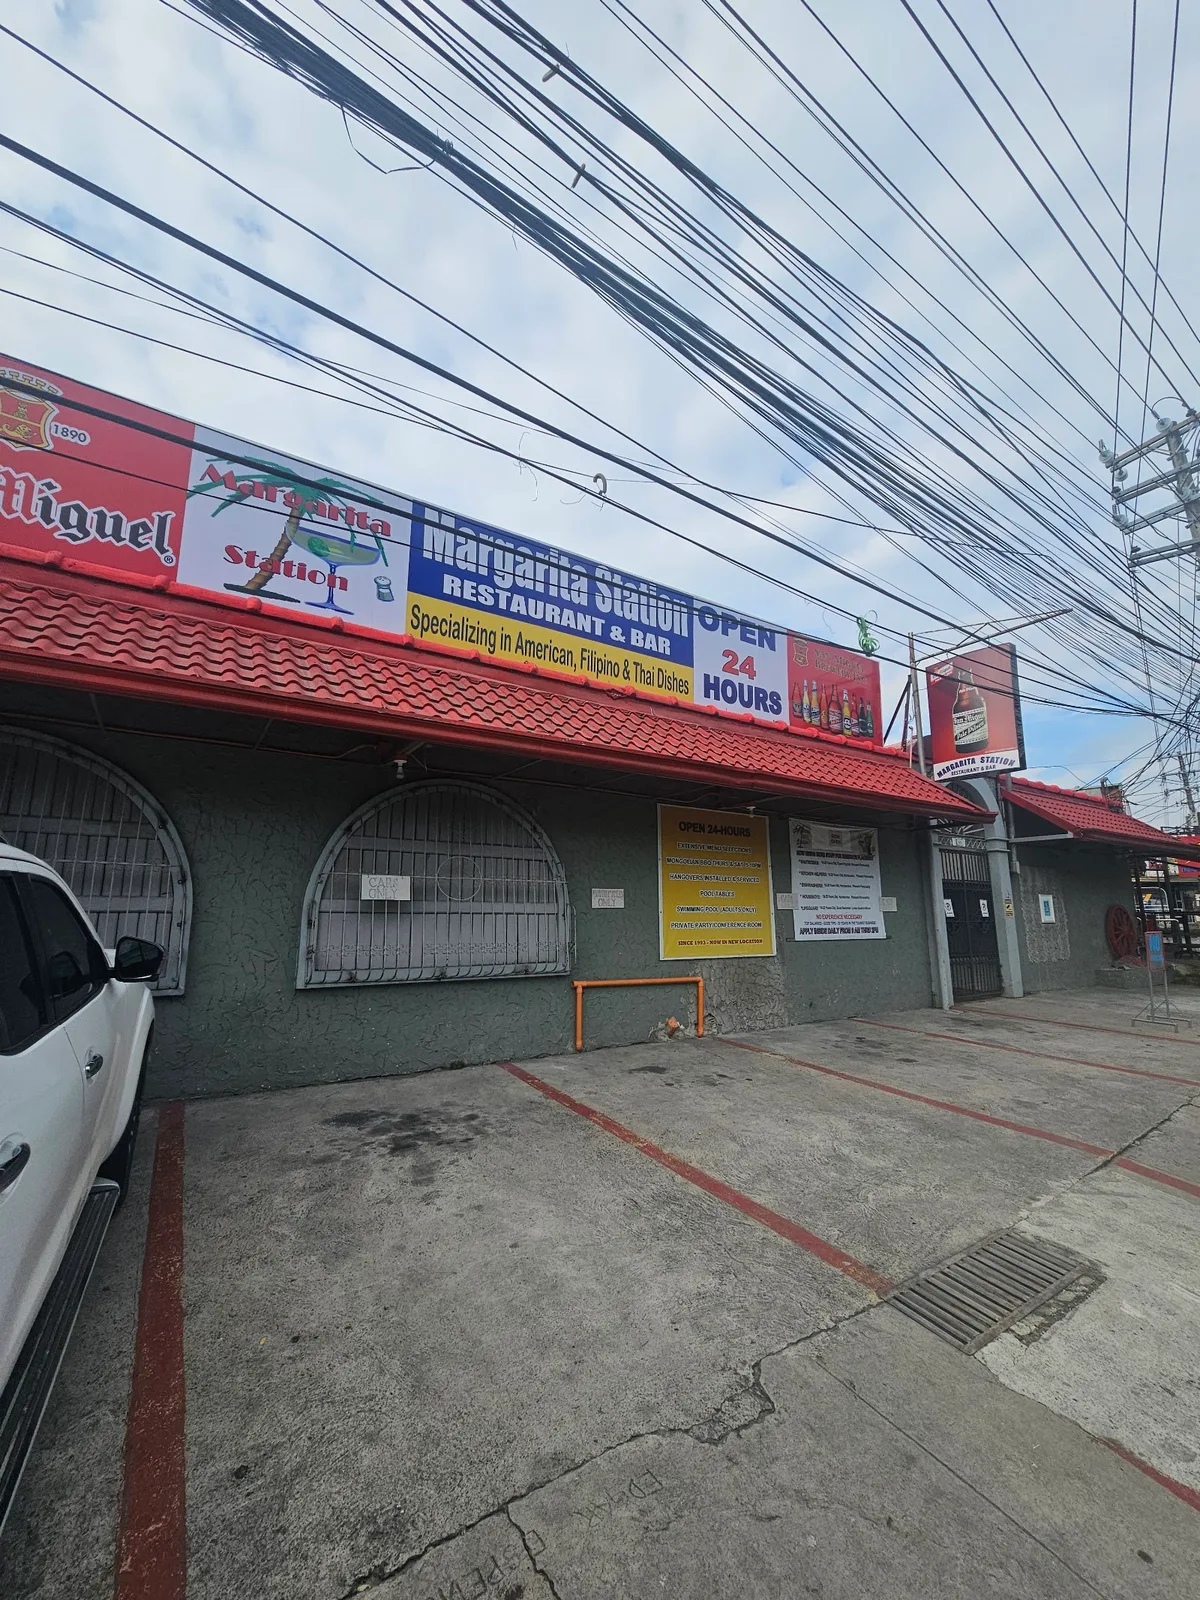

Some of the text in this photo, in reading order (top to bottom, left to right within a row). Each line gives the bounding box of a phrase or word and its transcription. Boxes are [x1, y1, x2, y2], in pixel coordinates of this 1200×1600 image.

[53, 424, 87, 443] 1890
[199, 463, 392, 538] Margarita
[223, 544, 349, 592] Station
[422, 505, 690, 638] Margarita Station
[443, 573, 671, 656] RESTAURANT & BAR
[698, 605, 776, 652] OPEN
[410, 603, 689, 696] Specializing in American, Filipino & Thai Dishes
[721, 649, 757, 681] 24
[703, 673, 783, 716] HOURS
[936, 756, 1016, 778] MARGARITA STATION
[678, 821, 751, 837] OPEN 24-HOURS
[369, 877, 398, 888] CARS
[369, 888, 397, 899] ONLY
